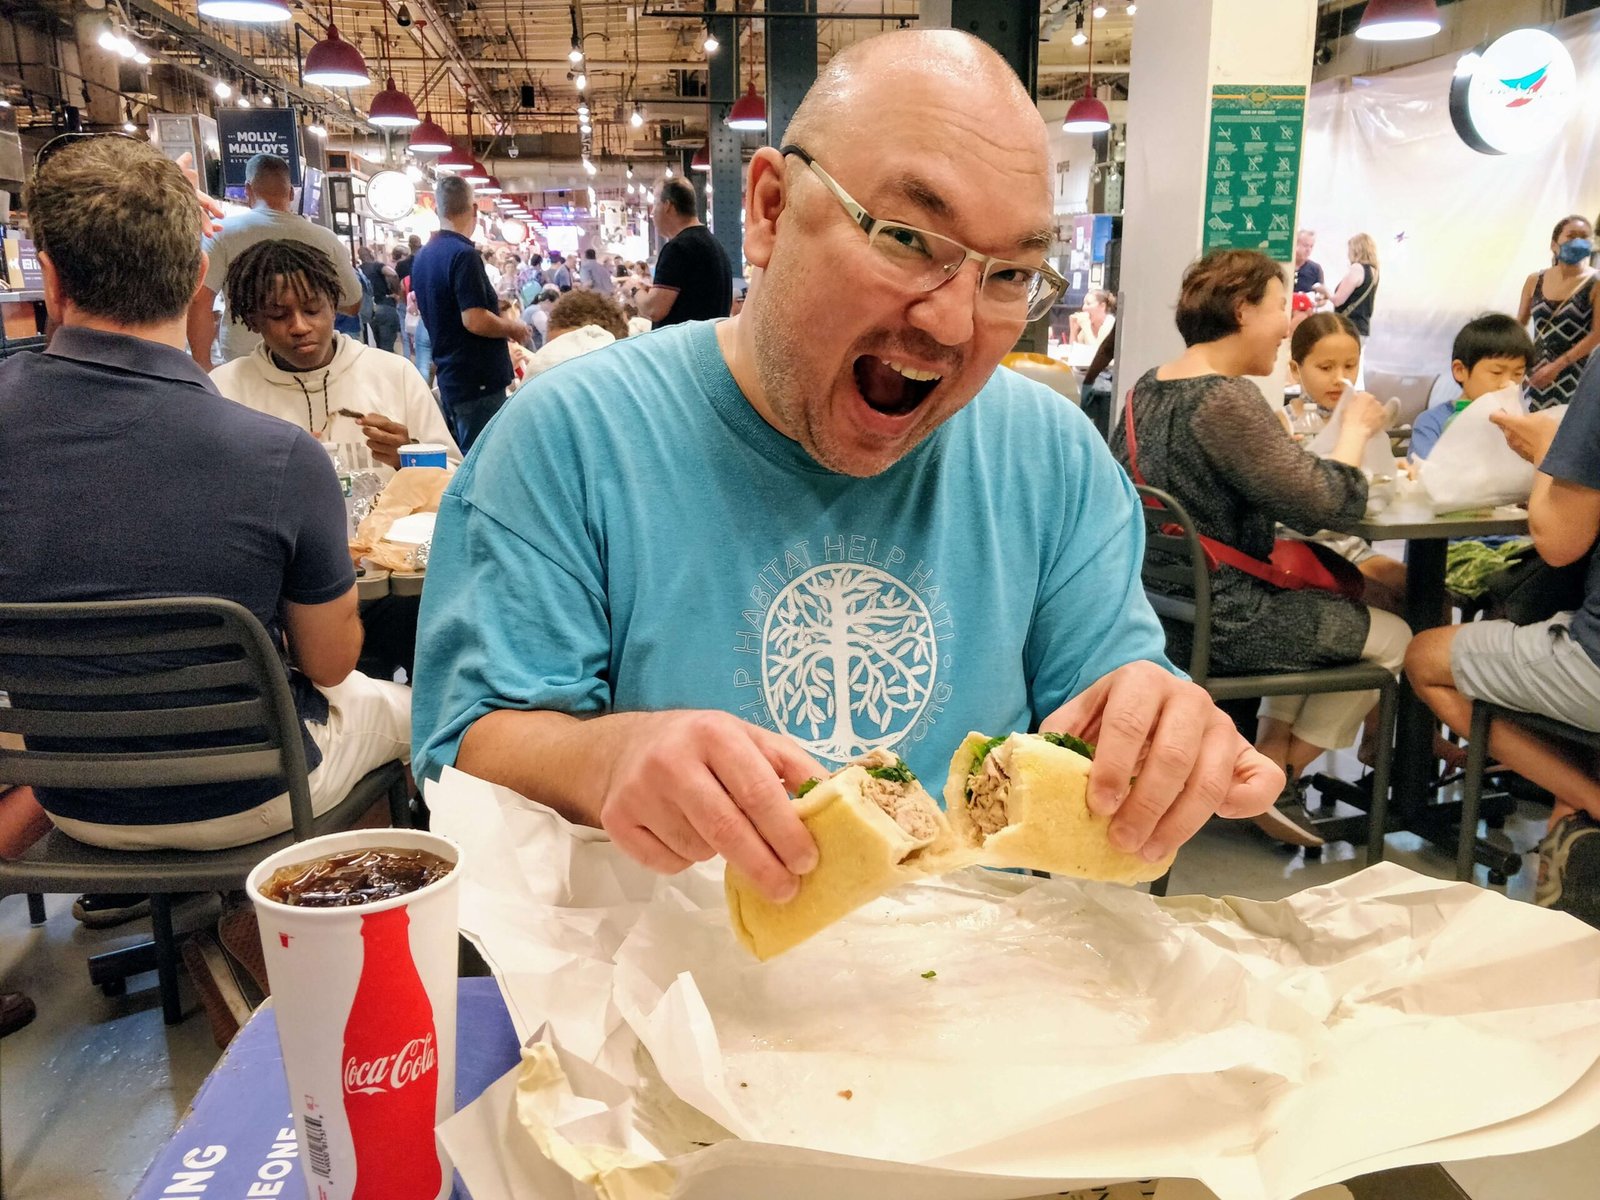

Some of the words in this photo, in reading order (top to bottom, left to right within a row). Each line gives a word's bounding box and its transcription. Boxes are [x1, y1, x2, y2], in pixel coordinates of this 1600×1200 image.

[229, 143, 288, 154] MALLOY'S
[237, 132, 277, 142] MOLLY
[733, 540, 813, 655] HABITAT
[823, 534, 906, 569] HELP
[906, 560, 955, 641] HAITI
[344, 1032, 435, 1095] Coca-Cola
